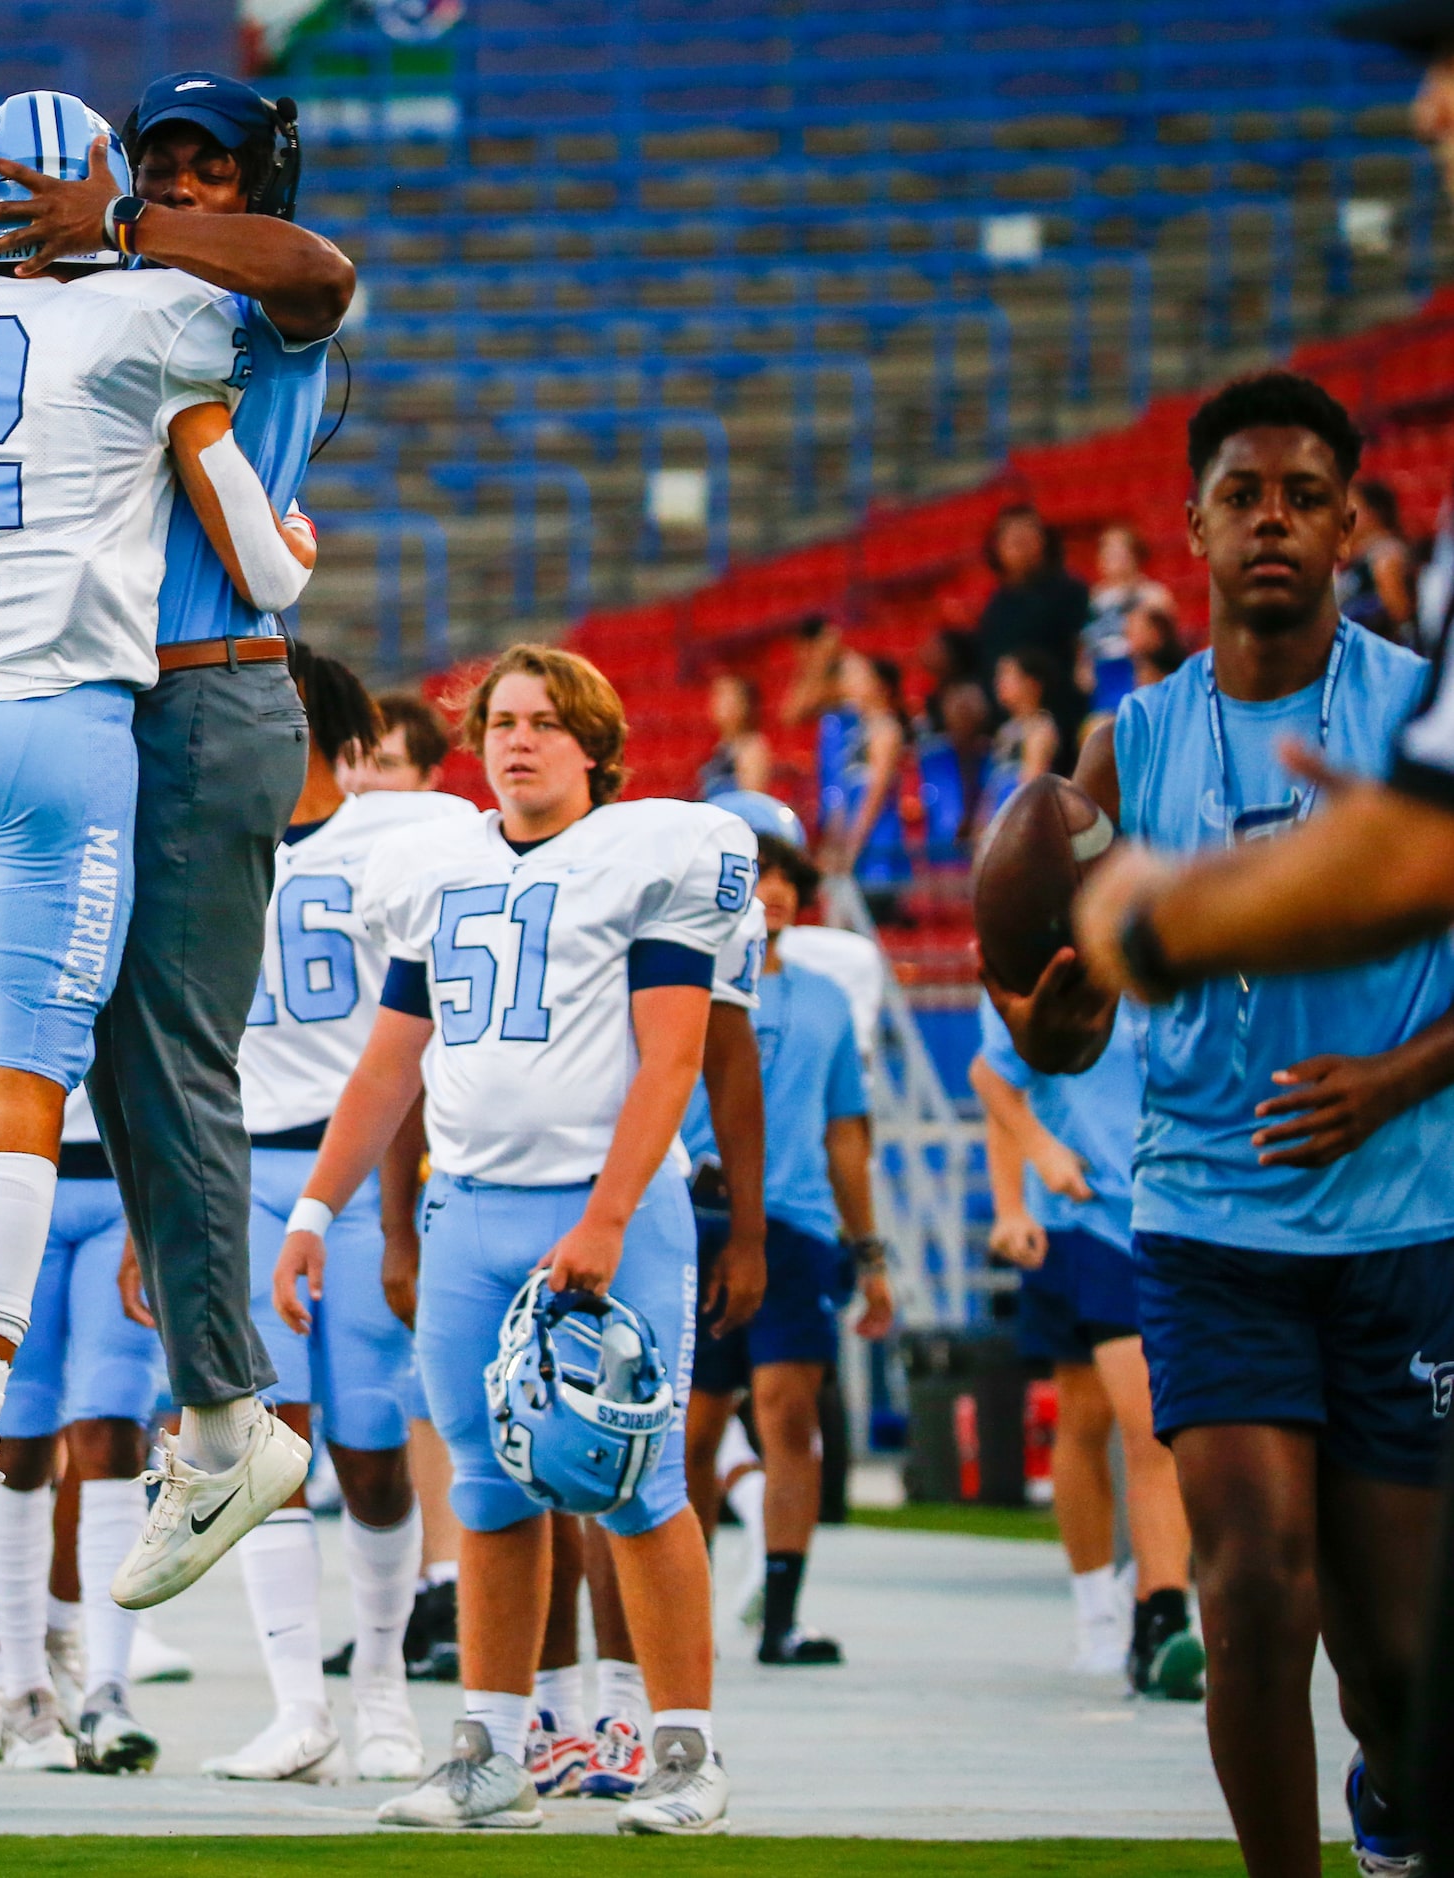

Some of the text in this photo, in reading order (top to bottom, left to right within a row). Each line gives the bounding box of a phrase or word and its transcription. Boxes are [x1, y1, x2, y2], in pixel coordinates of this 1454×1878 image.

[246, 873, 361, 1026] 6
[430, 881, 559, 1046] 51
[597, 1403, 670, 1431] AVERICKS
